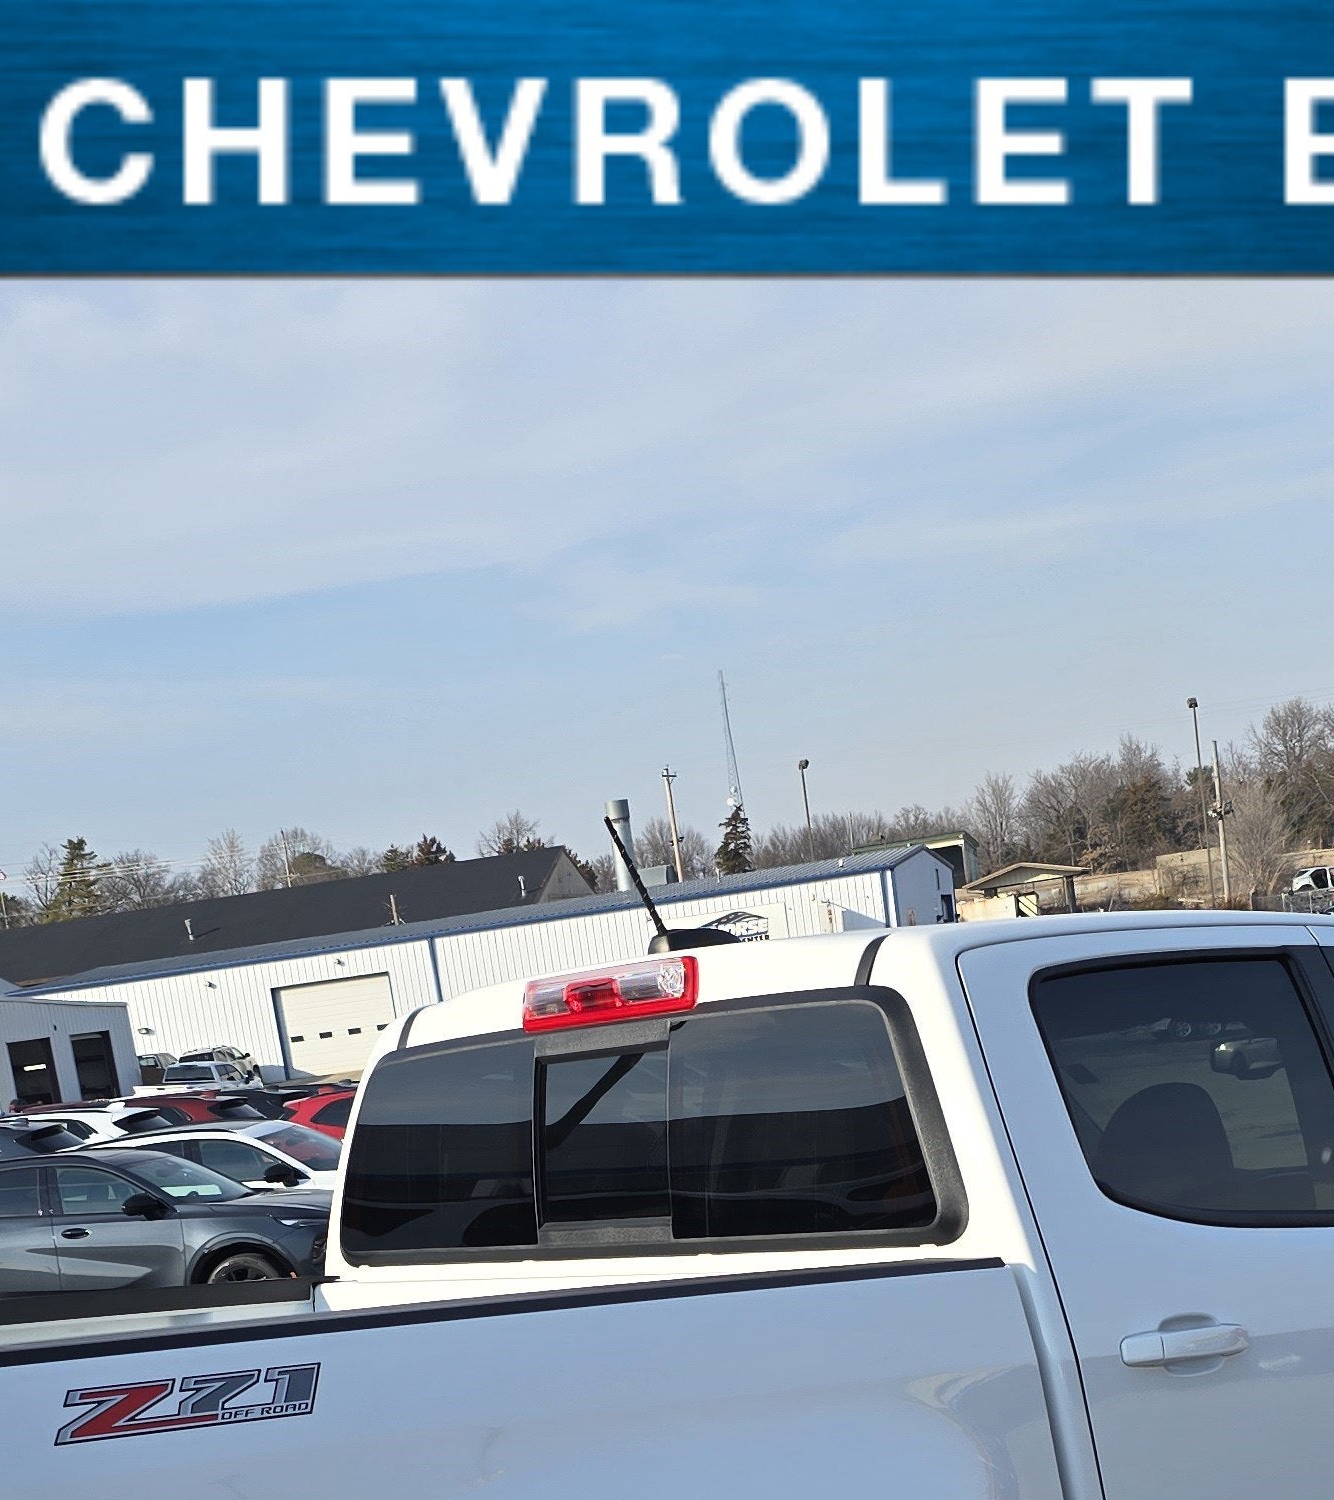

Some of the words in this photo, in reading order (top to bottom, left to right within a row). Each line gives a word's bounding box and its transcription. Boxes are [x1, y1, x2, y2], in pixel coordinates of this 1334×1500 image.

[54, 1362, 321, 1446] Z71
[221, 1408, 255, 1421] OFF
[260, 1401, 309, 1417] ROAD
